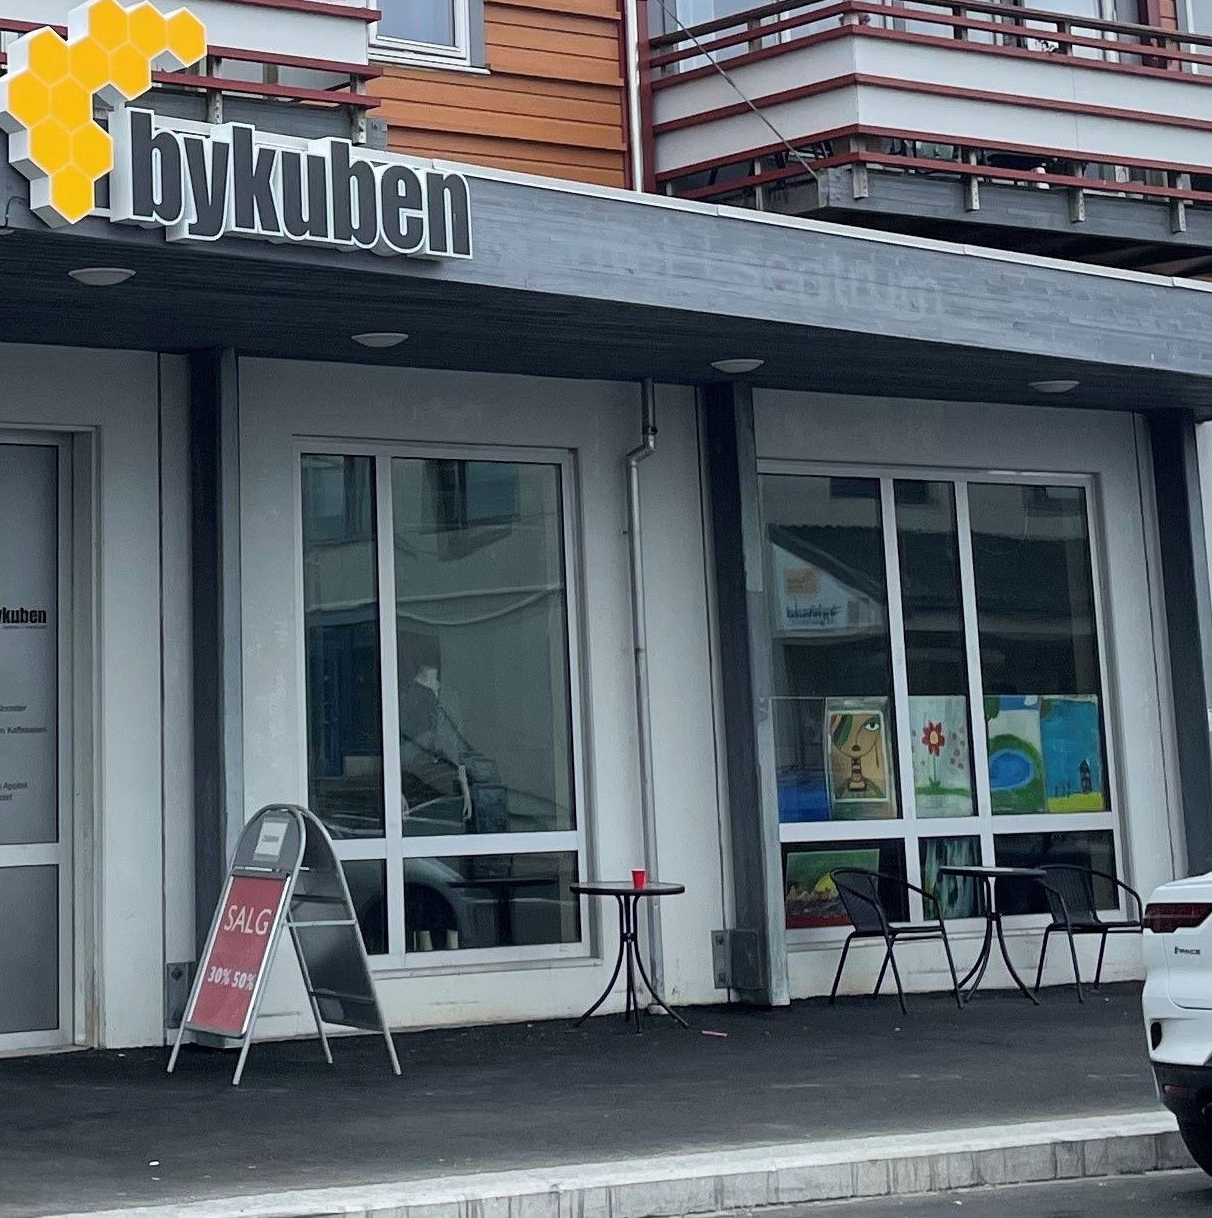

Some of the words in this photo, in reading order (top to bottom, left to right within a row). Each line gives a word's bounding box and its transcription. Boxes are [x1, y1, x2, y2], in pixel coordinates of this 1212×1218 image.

[129, 109, 472, 259] bykuben
[223, 904, 272, 935] SALG
[207, 966, 231, 985] 30%
[231, 971, 257, 991] 50%
